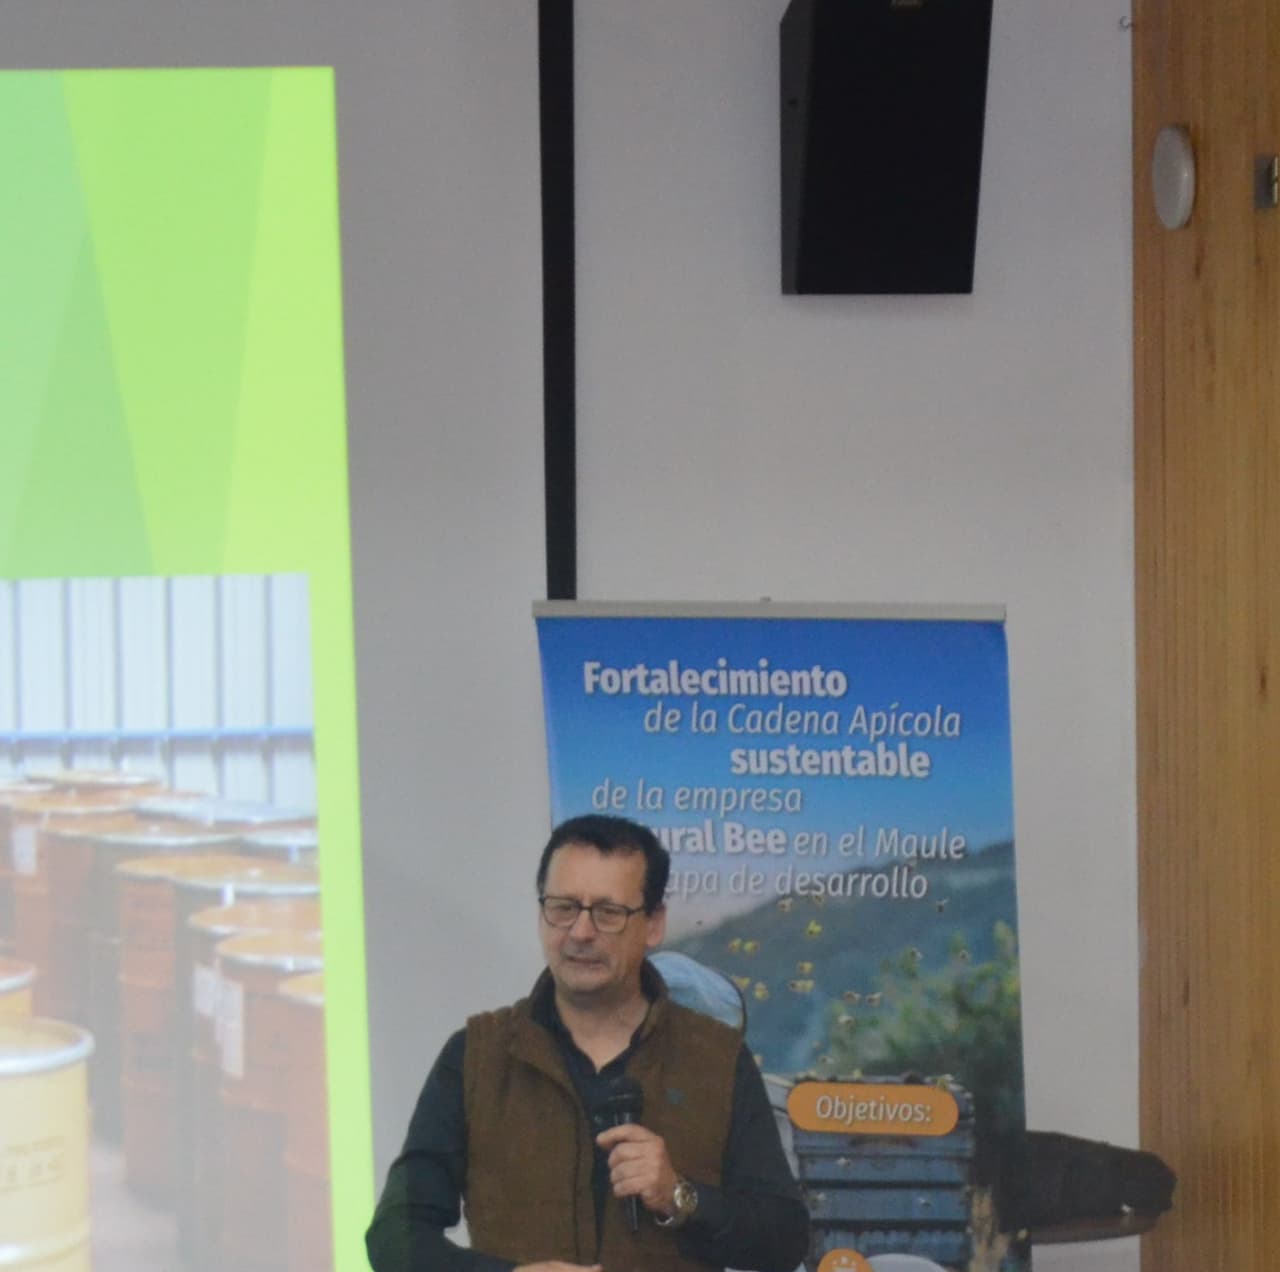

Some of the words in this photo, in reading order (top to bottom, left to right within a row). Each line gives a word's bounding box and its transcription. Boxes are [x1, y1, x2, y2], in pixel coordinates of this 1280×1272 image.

[583, 659, 848, 697] Fortalecimiento
[644, 703, 679, 733] de
[691, 703, 717, 733] la
[727, 703, 840, 735] Cadena
[849, 702, 961, 743] Apícola
[730, 743, 931, 778] sustentable
[592, 778, 627, 811] de
[637, 779, 663, 811] la
[674, 786, 803, 817] empresa
[650, 818, 716, 853] ural
[724, 821, 786, 854] Bee
[794, 830, 828, 857] en
[839, 827, 865, 858] el
[875, 828, 966, 860] Maule
[664, 871, 717, 902] apa
[730, 864, 763, 897] de
[775, 865, 928, 900] desarrollo
[815, 1095, 932, 1126] Objetivos:
